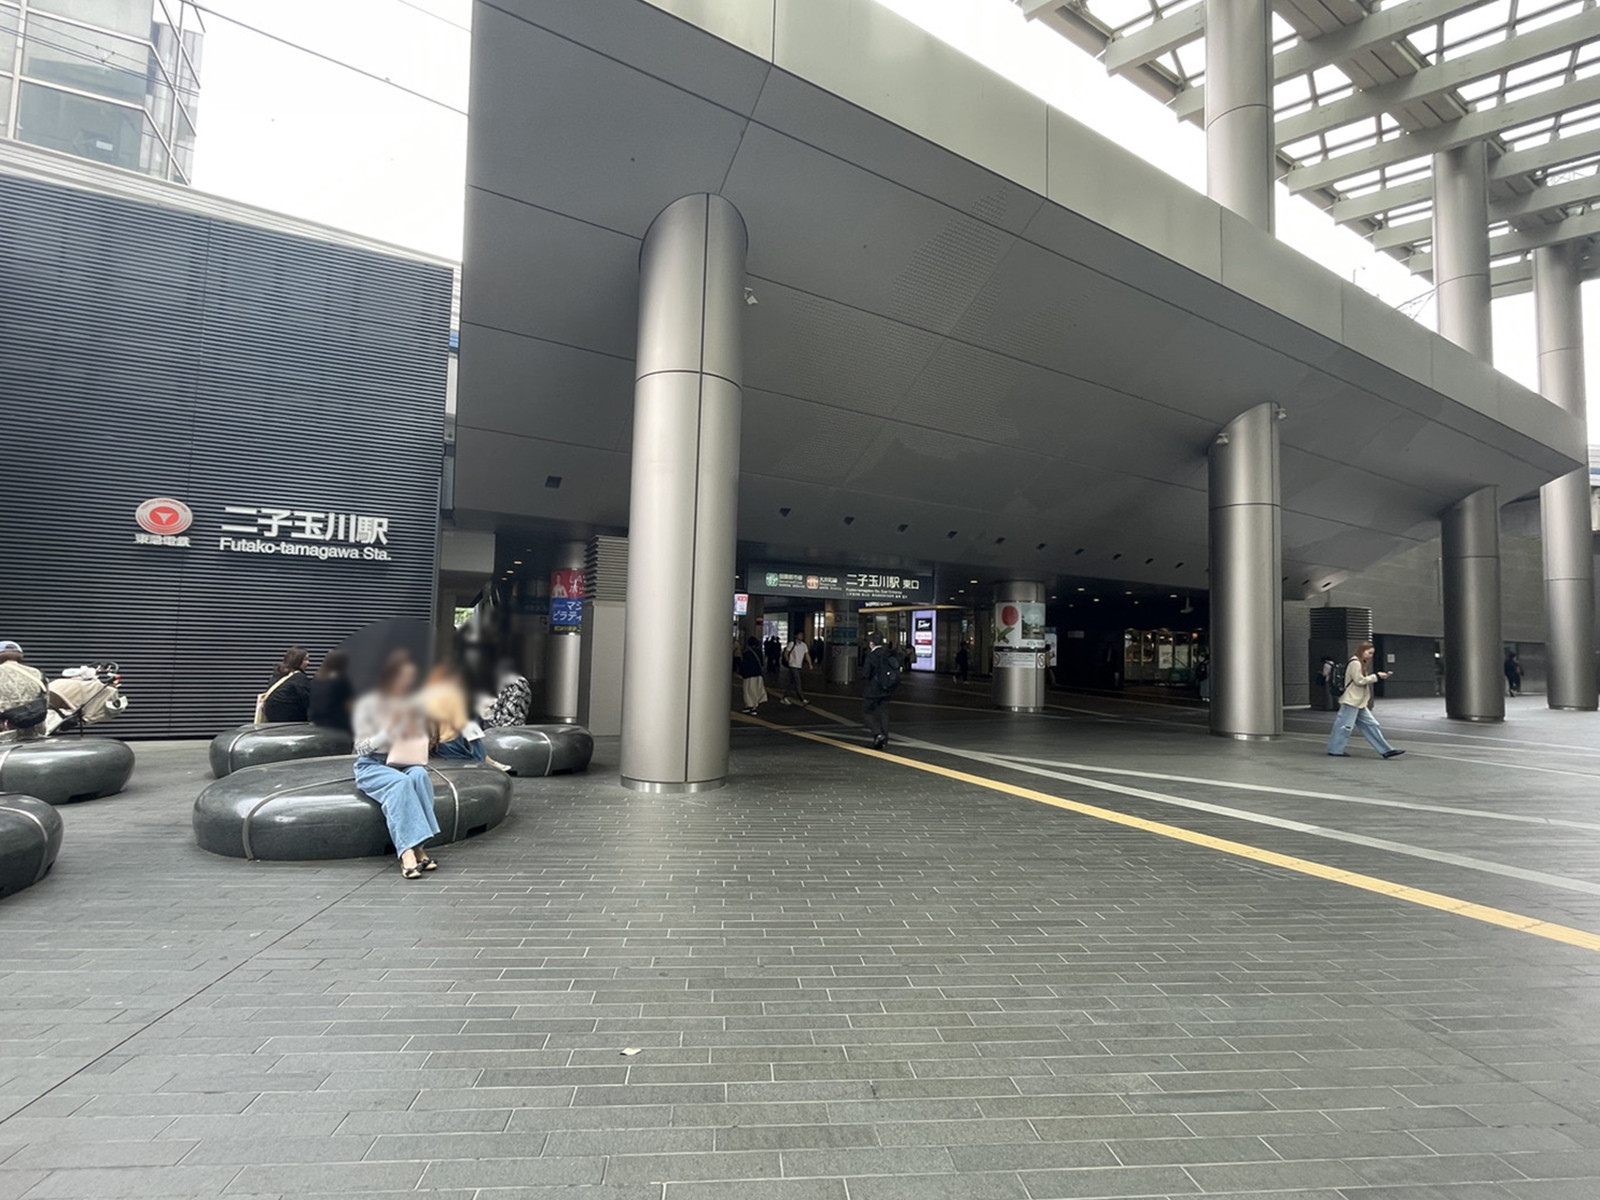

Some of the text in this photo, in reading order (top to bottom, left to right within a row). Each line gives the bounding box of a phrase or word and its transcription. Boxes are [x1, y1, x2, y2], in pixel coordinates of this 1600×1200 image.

[221, 506, 389, 545] 二子玉川駅
[219, 537, 392, 561] Futako-tamagawa Sta.
[846, 573, 900, 588] 二子玉川駅
[902, 579, 919, 590] 東口
